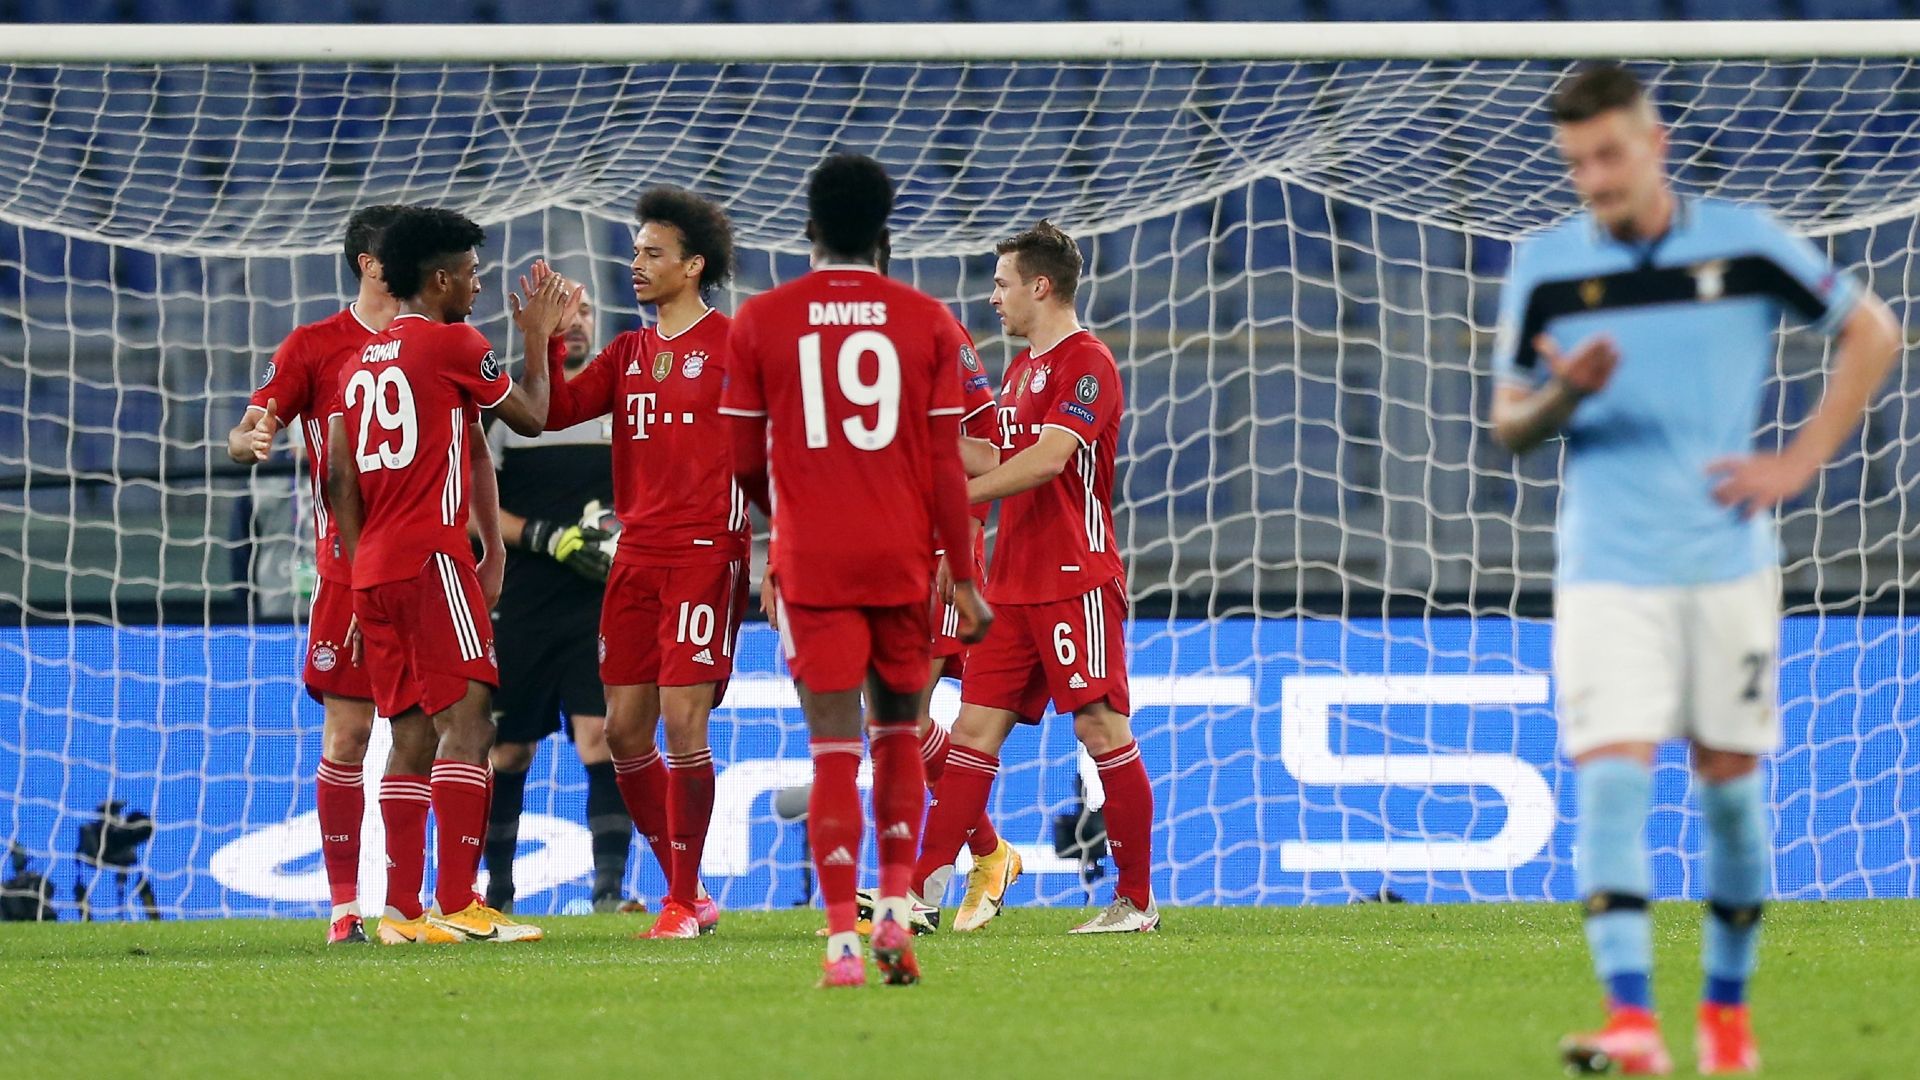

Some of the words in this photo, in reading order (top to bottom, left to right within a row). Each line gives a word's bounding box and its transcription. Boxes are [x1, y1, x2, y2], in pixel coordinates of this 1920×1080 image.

[808, 301, 887, 326] DAVIES
[361, 339, 401, 363] COMAN
[798, 330, 901, 451] 19
[1083, 388, 1090, 397] 6
[345, 366, 418, 474] 29
[1069, 405, 1094, 422] RESPECT
[676, 601, 715, 647] 10
[1053, 622, 1077, 666] 6
[324, 834, 349, 842] FCB
[461, 835, 480, 846] FCB
[670, 840, 687, 851] FCB
